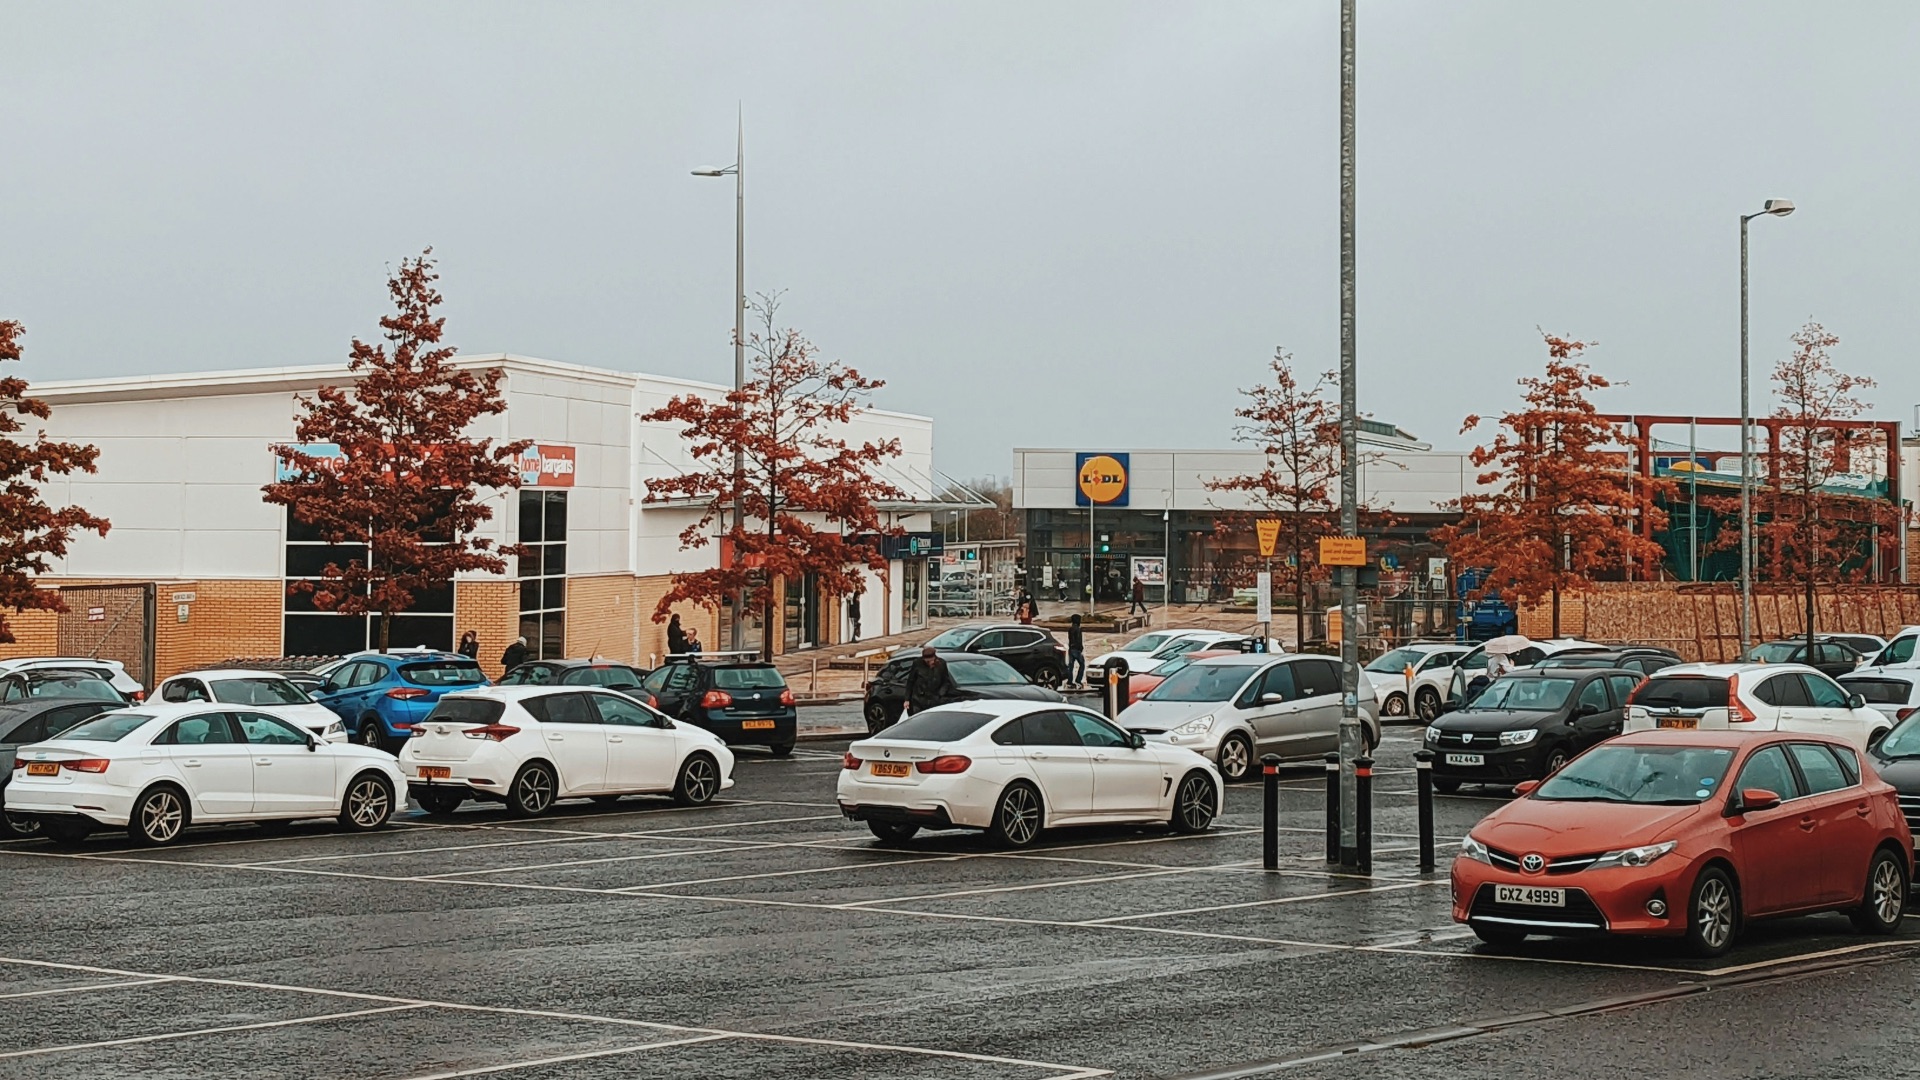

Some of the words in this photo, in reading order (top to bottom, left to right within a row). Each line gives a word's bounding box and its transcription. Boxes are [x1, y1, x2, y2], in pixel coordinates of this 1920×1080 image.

[541, 452, 574, 479] bargains
[1500, 888, 1522, 901] GXZ
[1526, 889, 1559, 904] 4999
